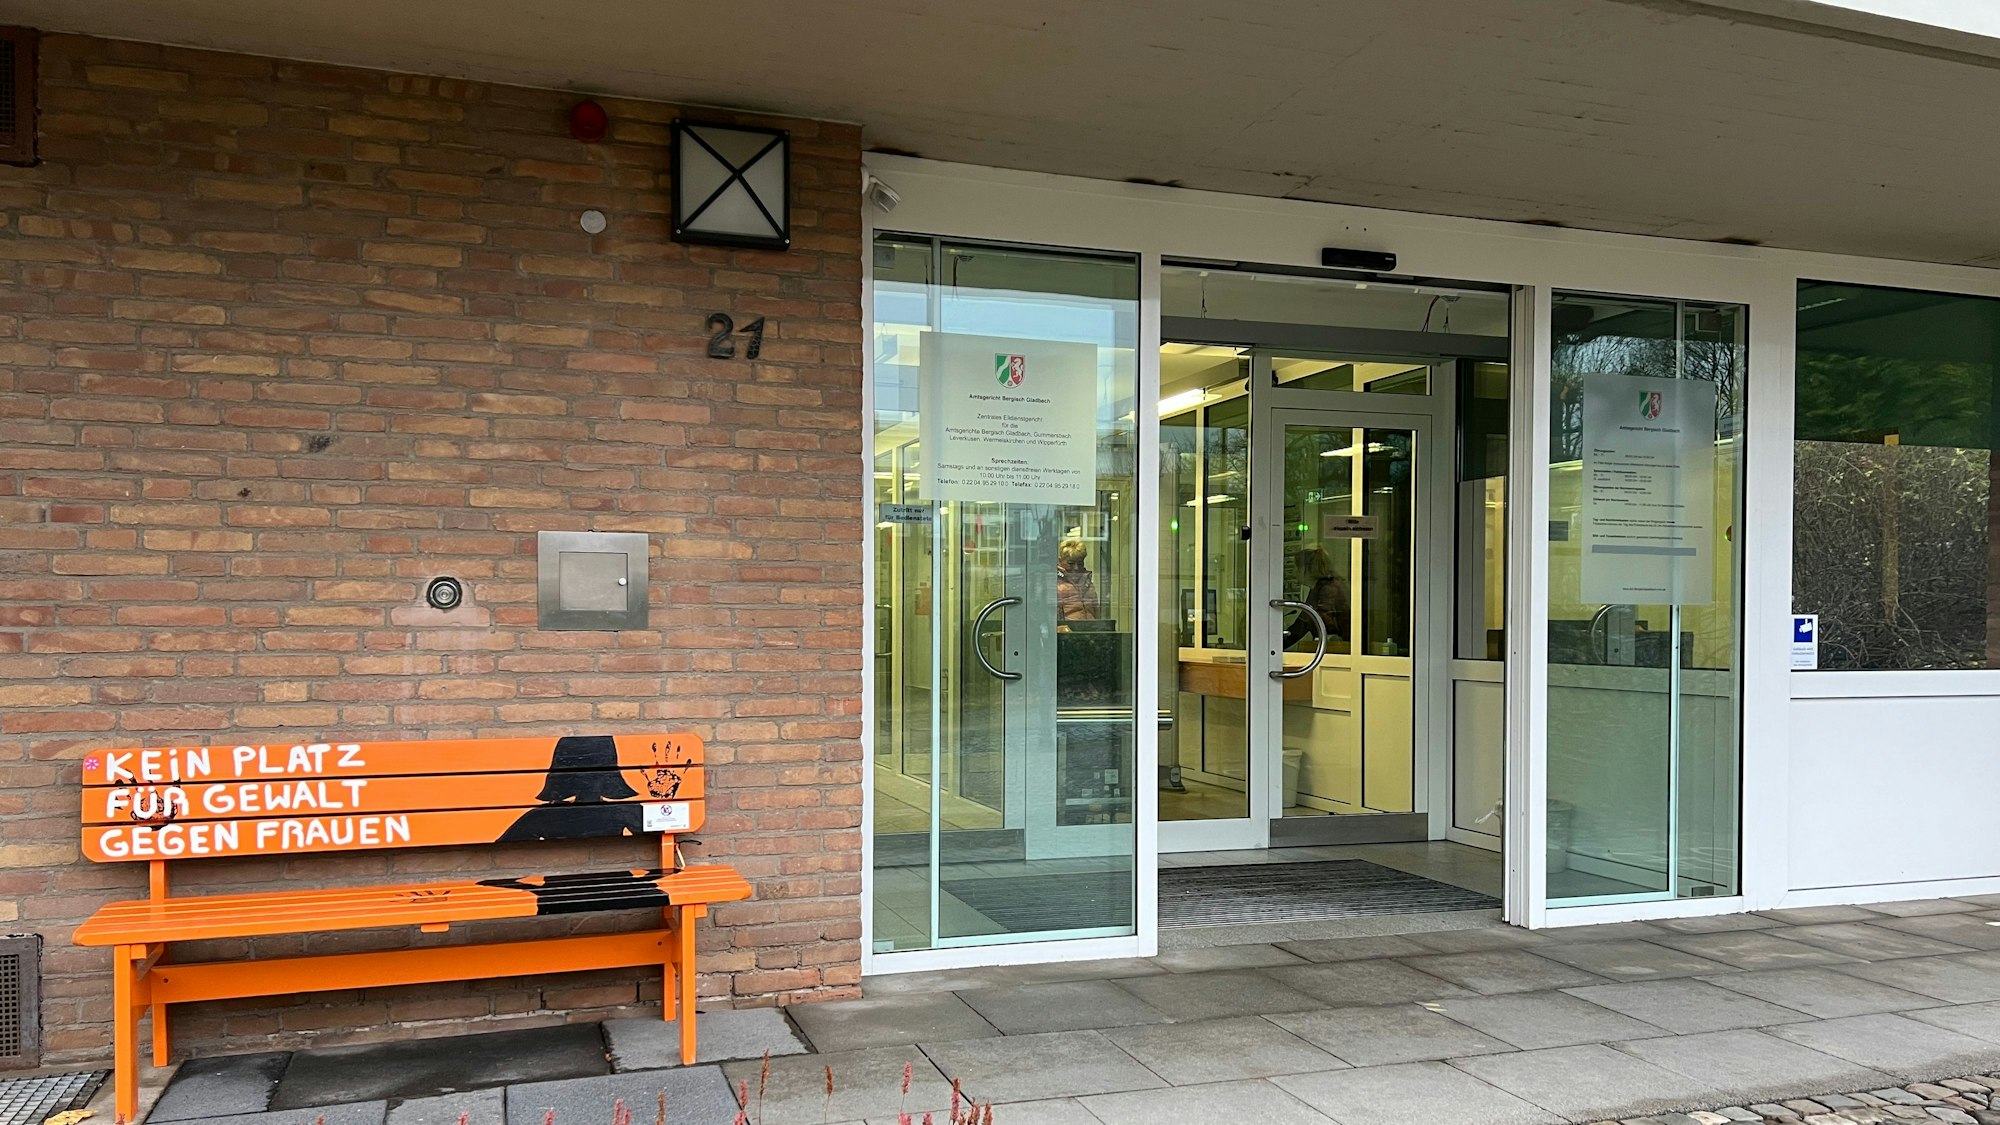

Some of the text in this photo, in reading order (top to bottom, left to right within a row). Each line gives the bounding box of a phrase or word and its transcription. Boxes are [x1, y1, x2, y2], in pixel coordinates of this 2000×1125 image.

[707, 312, 765, 359] 21
[969, 393, 1001, 401] Amtsgericht
[945, 427, 980, 435] Amtsgerichte
[981, 428, 1005, 436] Bergisch
[937, 462, 964, 471] Samstags
[233, 744, 366, 777] PLATZ
[106, 780, 368, 819] FÜR GEWALT
[99, 815, 411, 858] GEGEN FRAUEN
